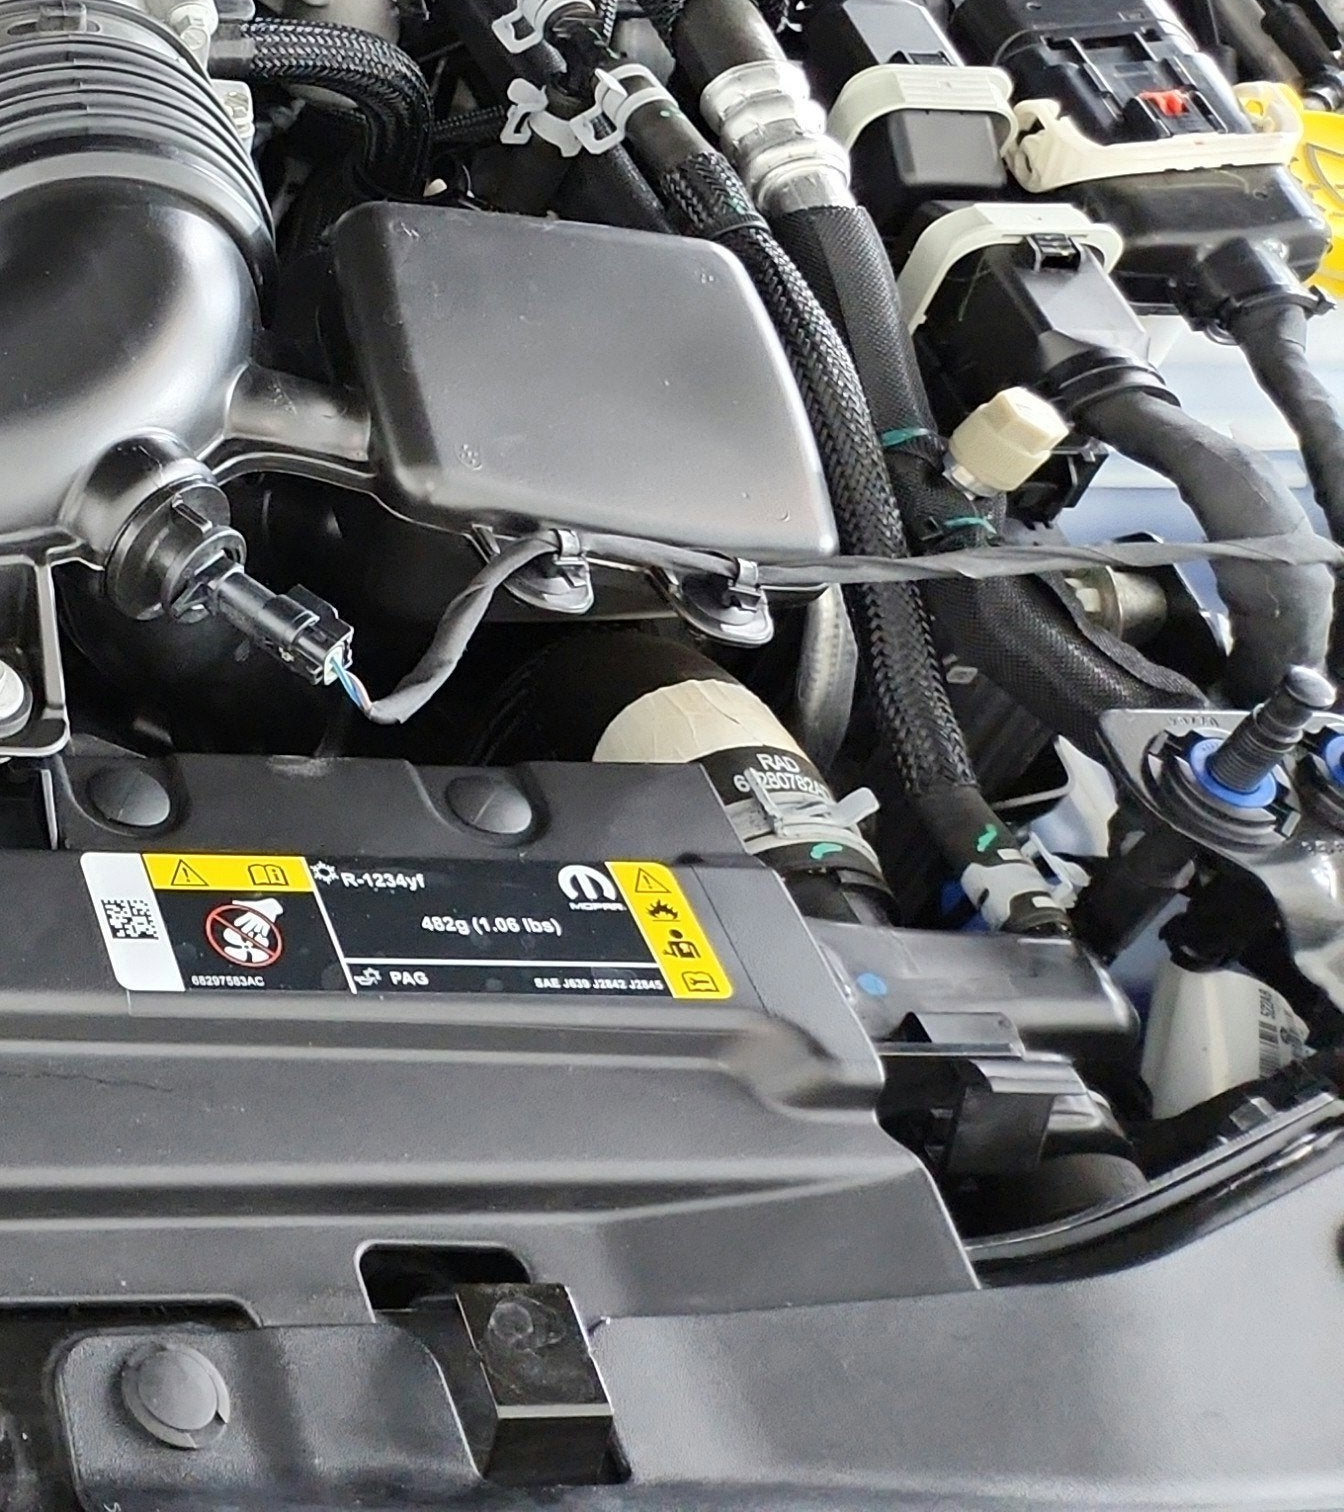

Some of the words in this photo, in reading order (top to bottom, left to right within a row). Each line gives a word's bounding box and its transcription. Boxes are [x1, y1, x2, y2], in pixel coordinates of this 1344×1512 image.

[756, 753, 800, 773] RAD
[340, 872, 426, 891] R-1234yf
[568, 902, 627, 911] MOPAR
[421, 916, 470, 935] 482g
[472, 916, 520, 935] (1.06
[522, 917, 562, 937] lbs)
[389, 971, 429, 986] PAG
[533, 977, 561, 988] SAE
